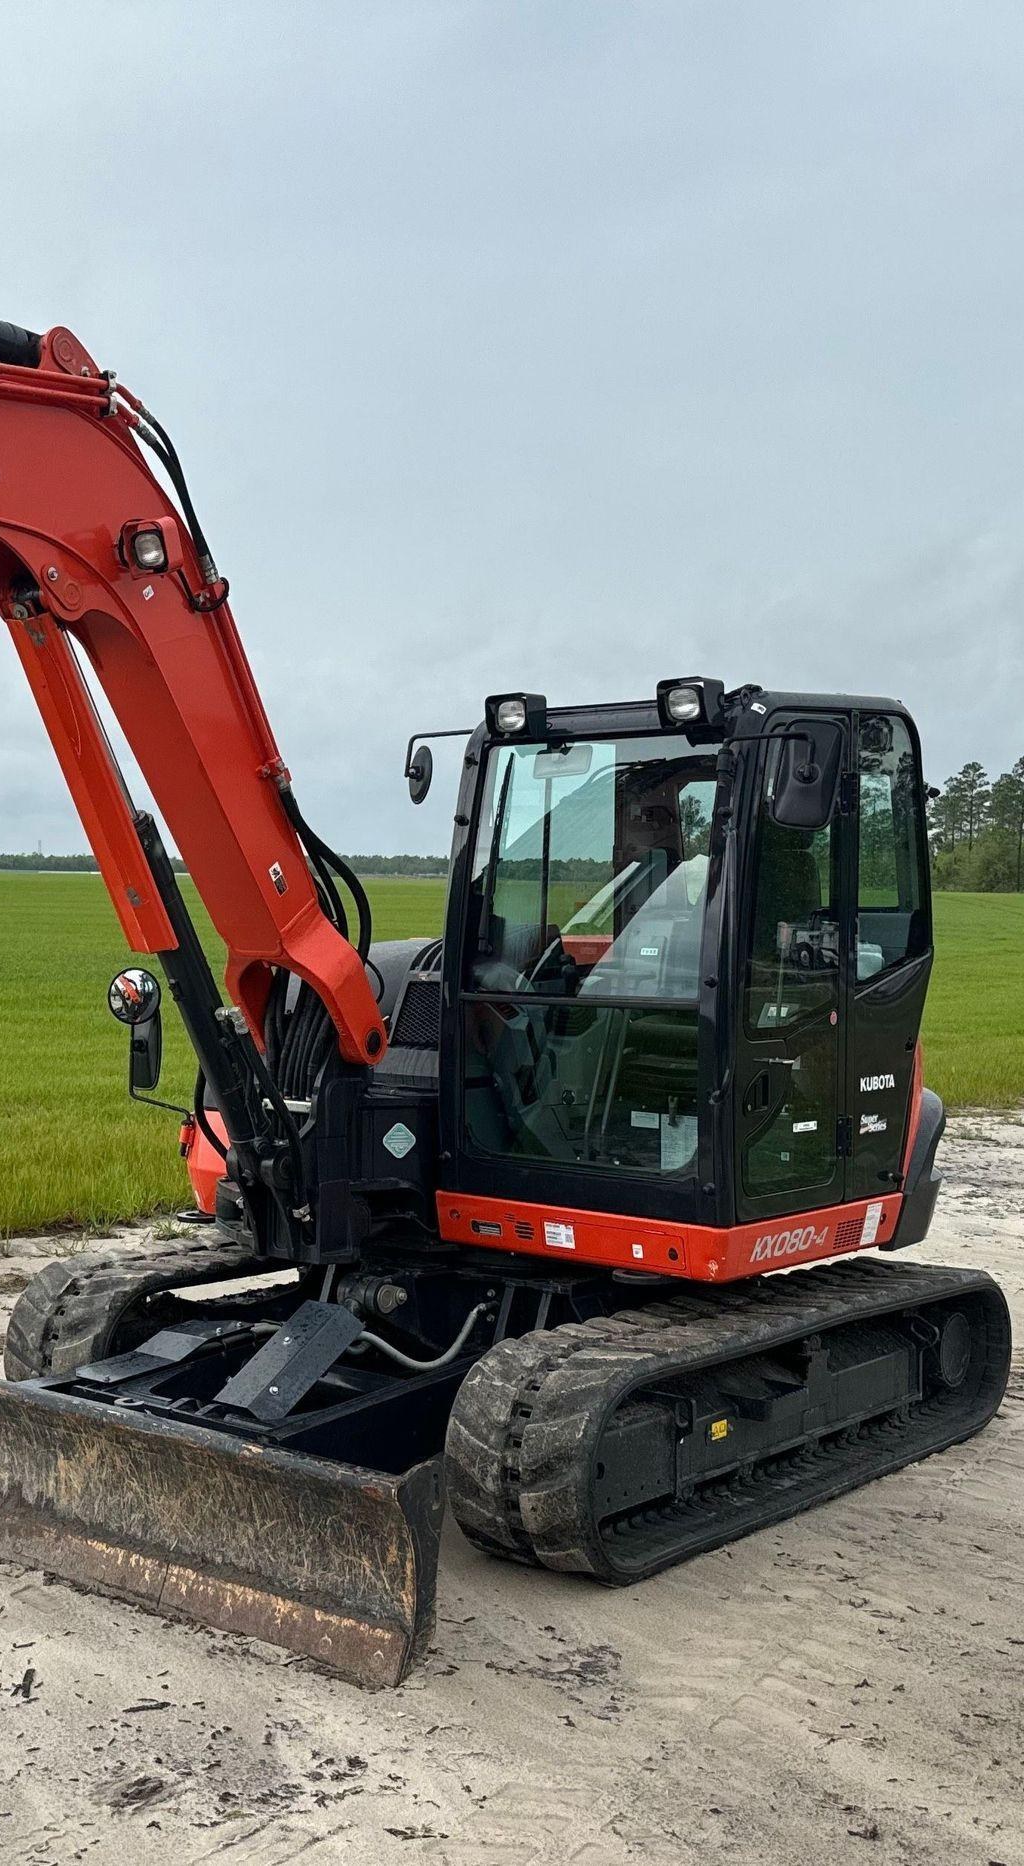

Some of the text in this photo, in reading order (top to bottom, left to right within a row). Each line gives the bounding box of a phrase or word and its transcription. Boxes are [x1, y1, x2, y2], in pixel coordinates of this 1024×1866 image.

[860, 1074, 895, 1092] KUBOTA
[861, 1114, 878, 1126] Super
[749, 1225, 829, 1263] KX080-4
